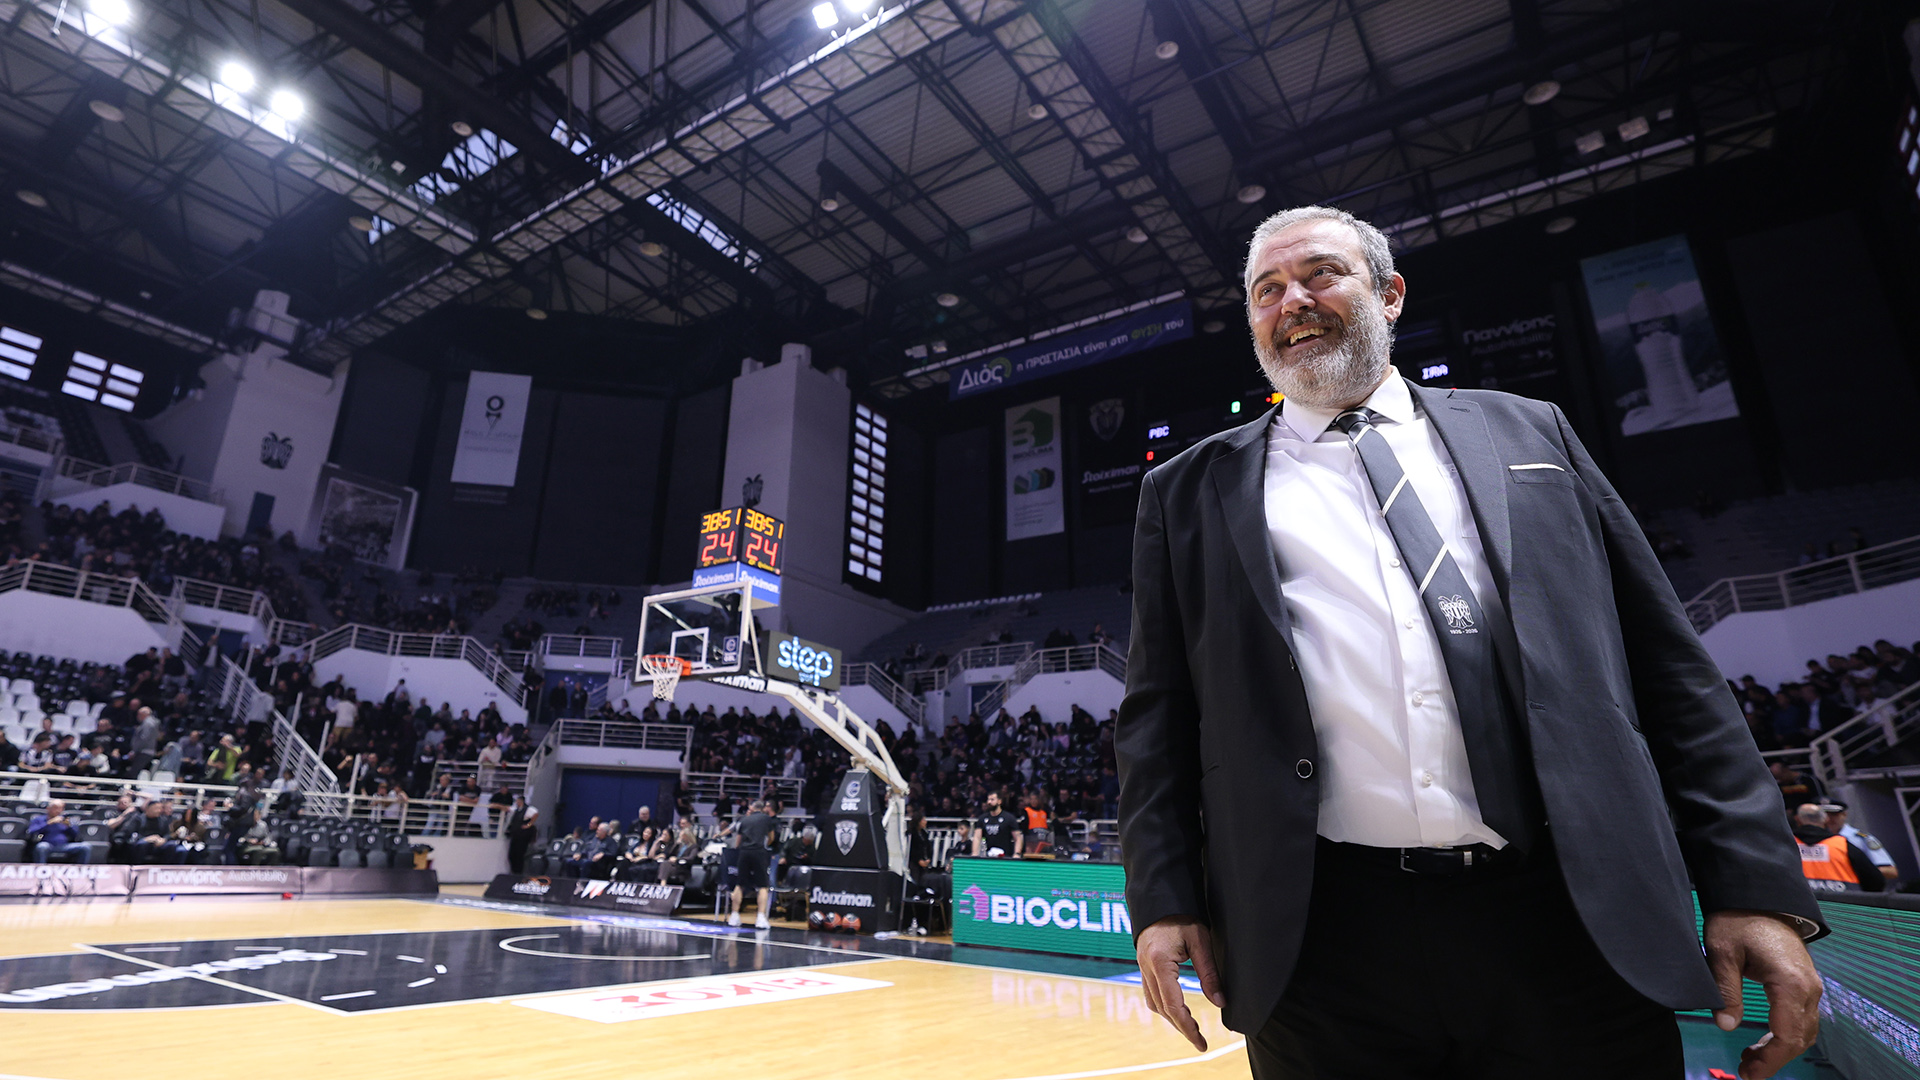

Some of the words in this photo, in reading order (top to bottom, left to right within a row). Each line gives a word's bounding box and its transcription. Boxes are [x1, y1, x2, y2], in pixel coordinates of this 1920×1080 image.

[1025, 346, 1082, 370] ΠΡΟΣΤΑΣΙΑ
[1083, 340, 1108, 354] είναι
[701, 530, 736, 562] 24
[745, 532, 779, 567] 24
[777, 635, 834, 687] step
[0, 864, 112, 880] ΑΠΟΥΔΗΣ
[607, 882, 636, 898] ARAL
[639, 883, 673, 900] FARM
[809, 885, 873, 908] Stoiximan
